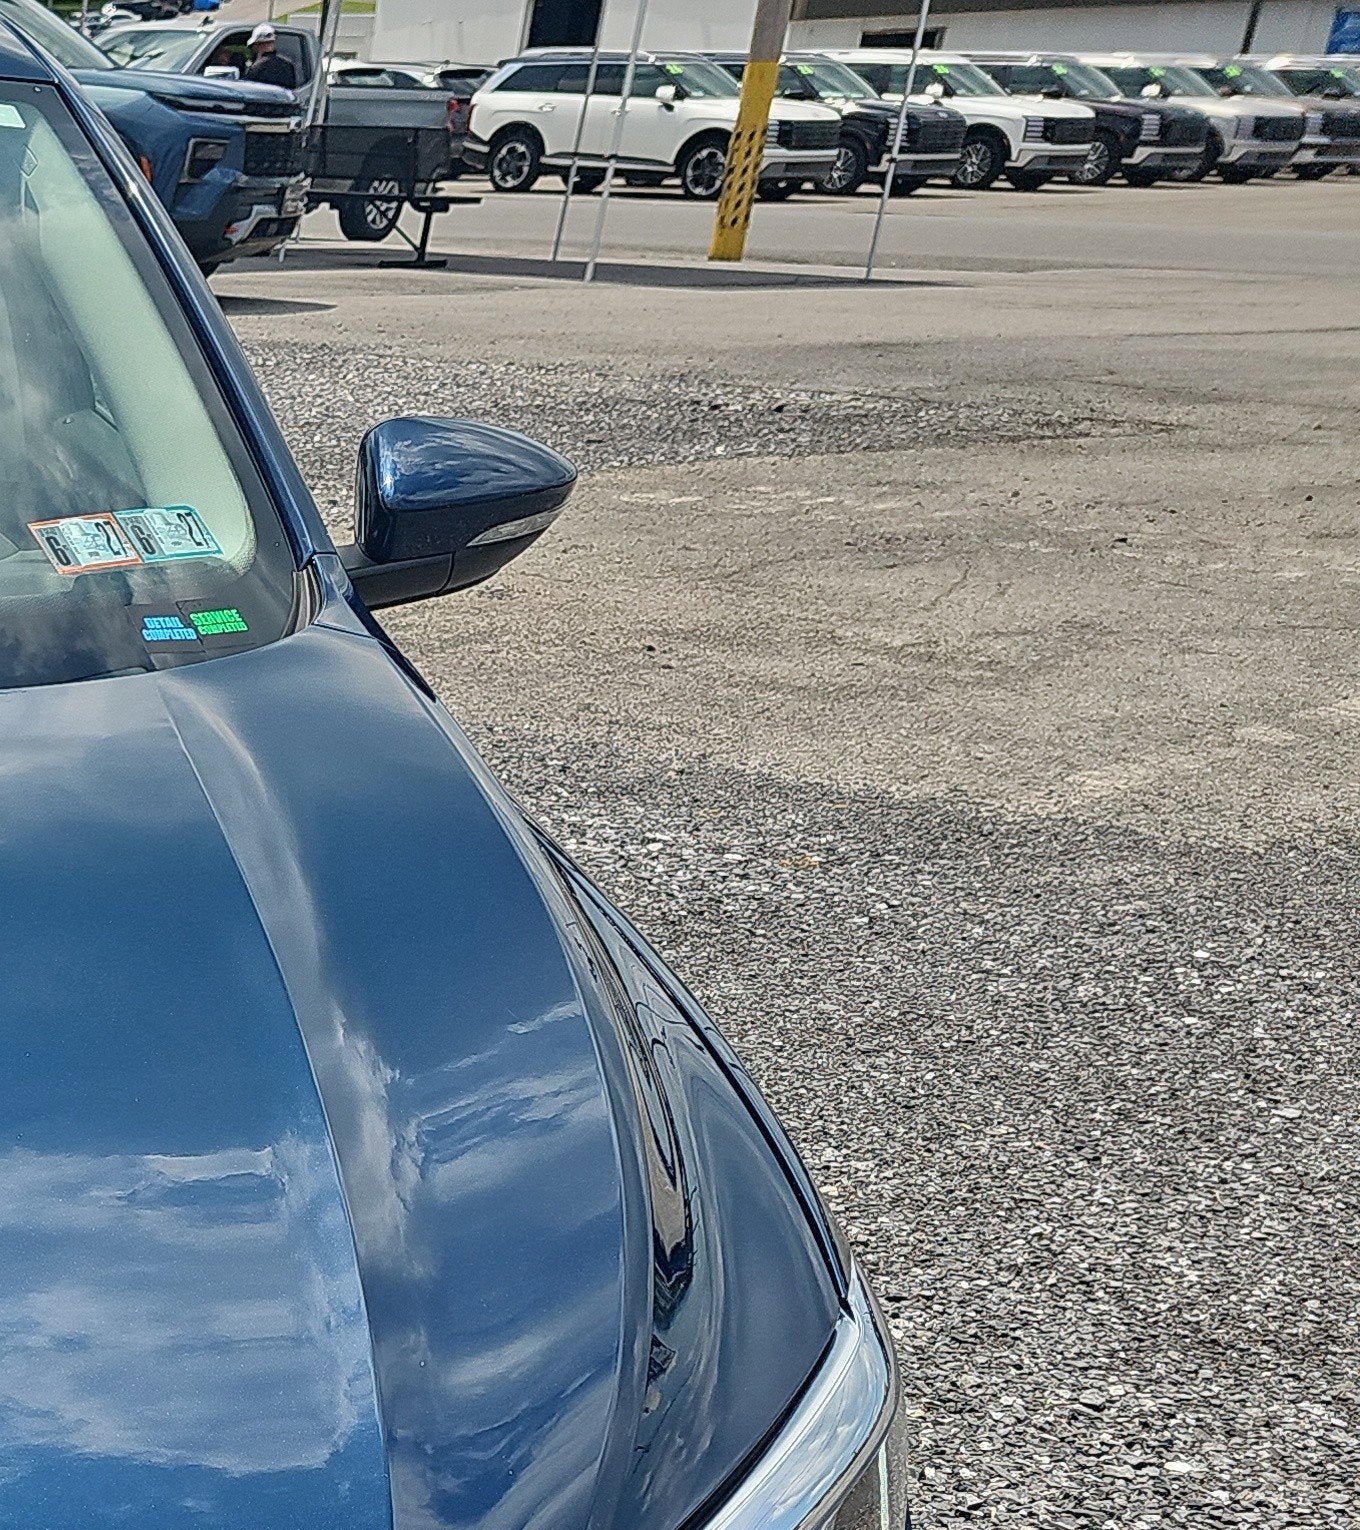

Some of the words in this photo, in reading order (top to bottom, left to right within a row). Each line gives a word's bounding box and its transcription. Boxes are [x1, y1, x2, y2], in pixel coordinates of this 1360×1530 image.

[176, 511, 211, 548] 27
[94, 520, 128, 557] 27
[143, 616, 185, 628] DETAIL
[189, 609, 243, 626] SERVICE
[141, 628, 198, 641] COMPLETED
[197, 621, 248, 635] COMPLETED
